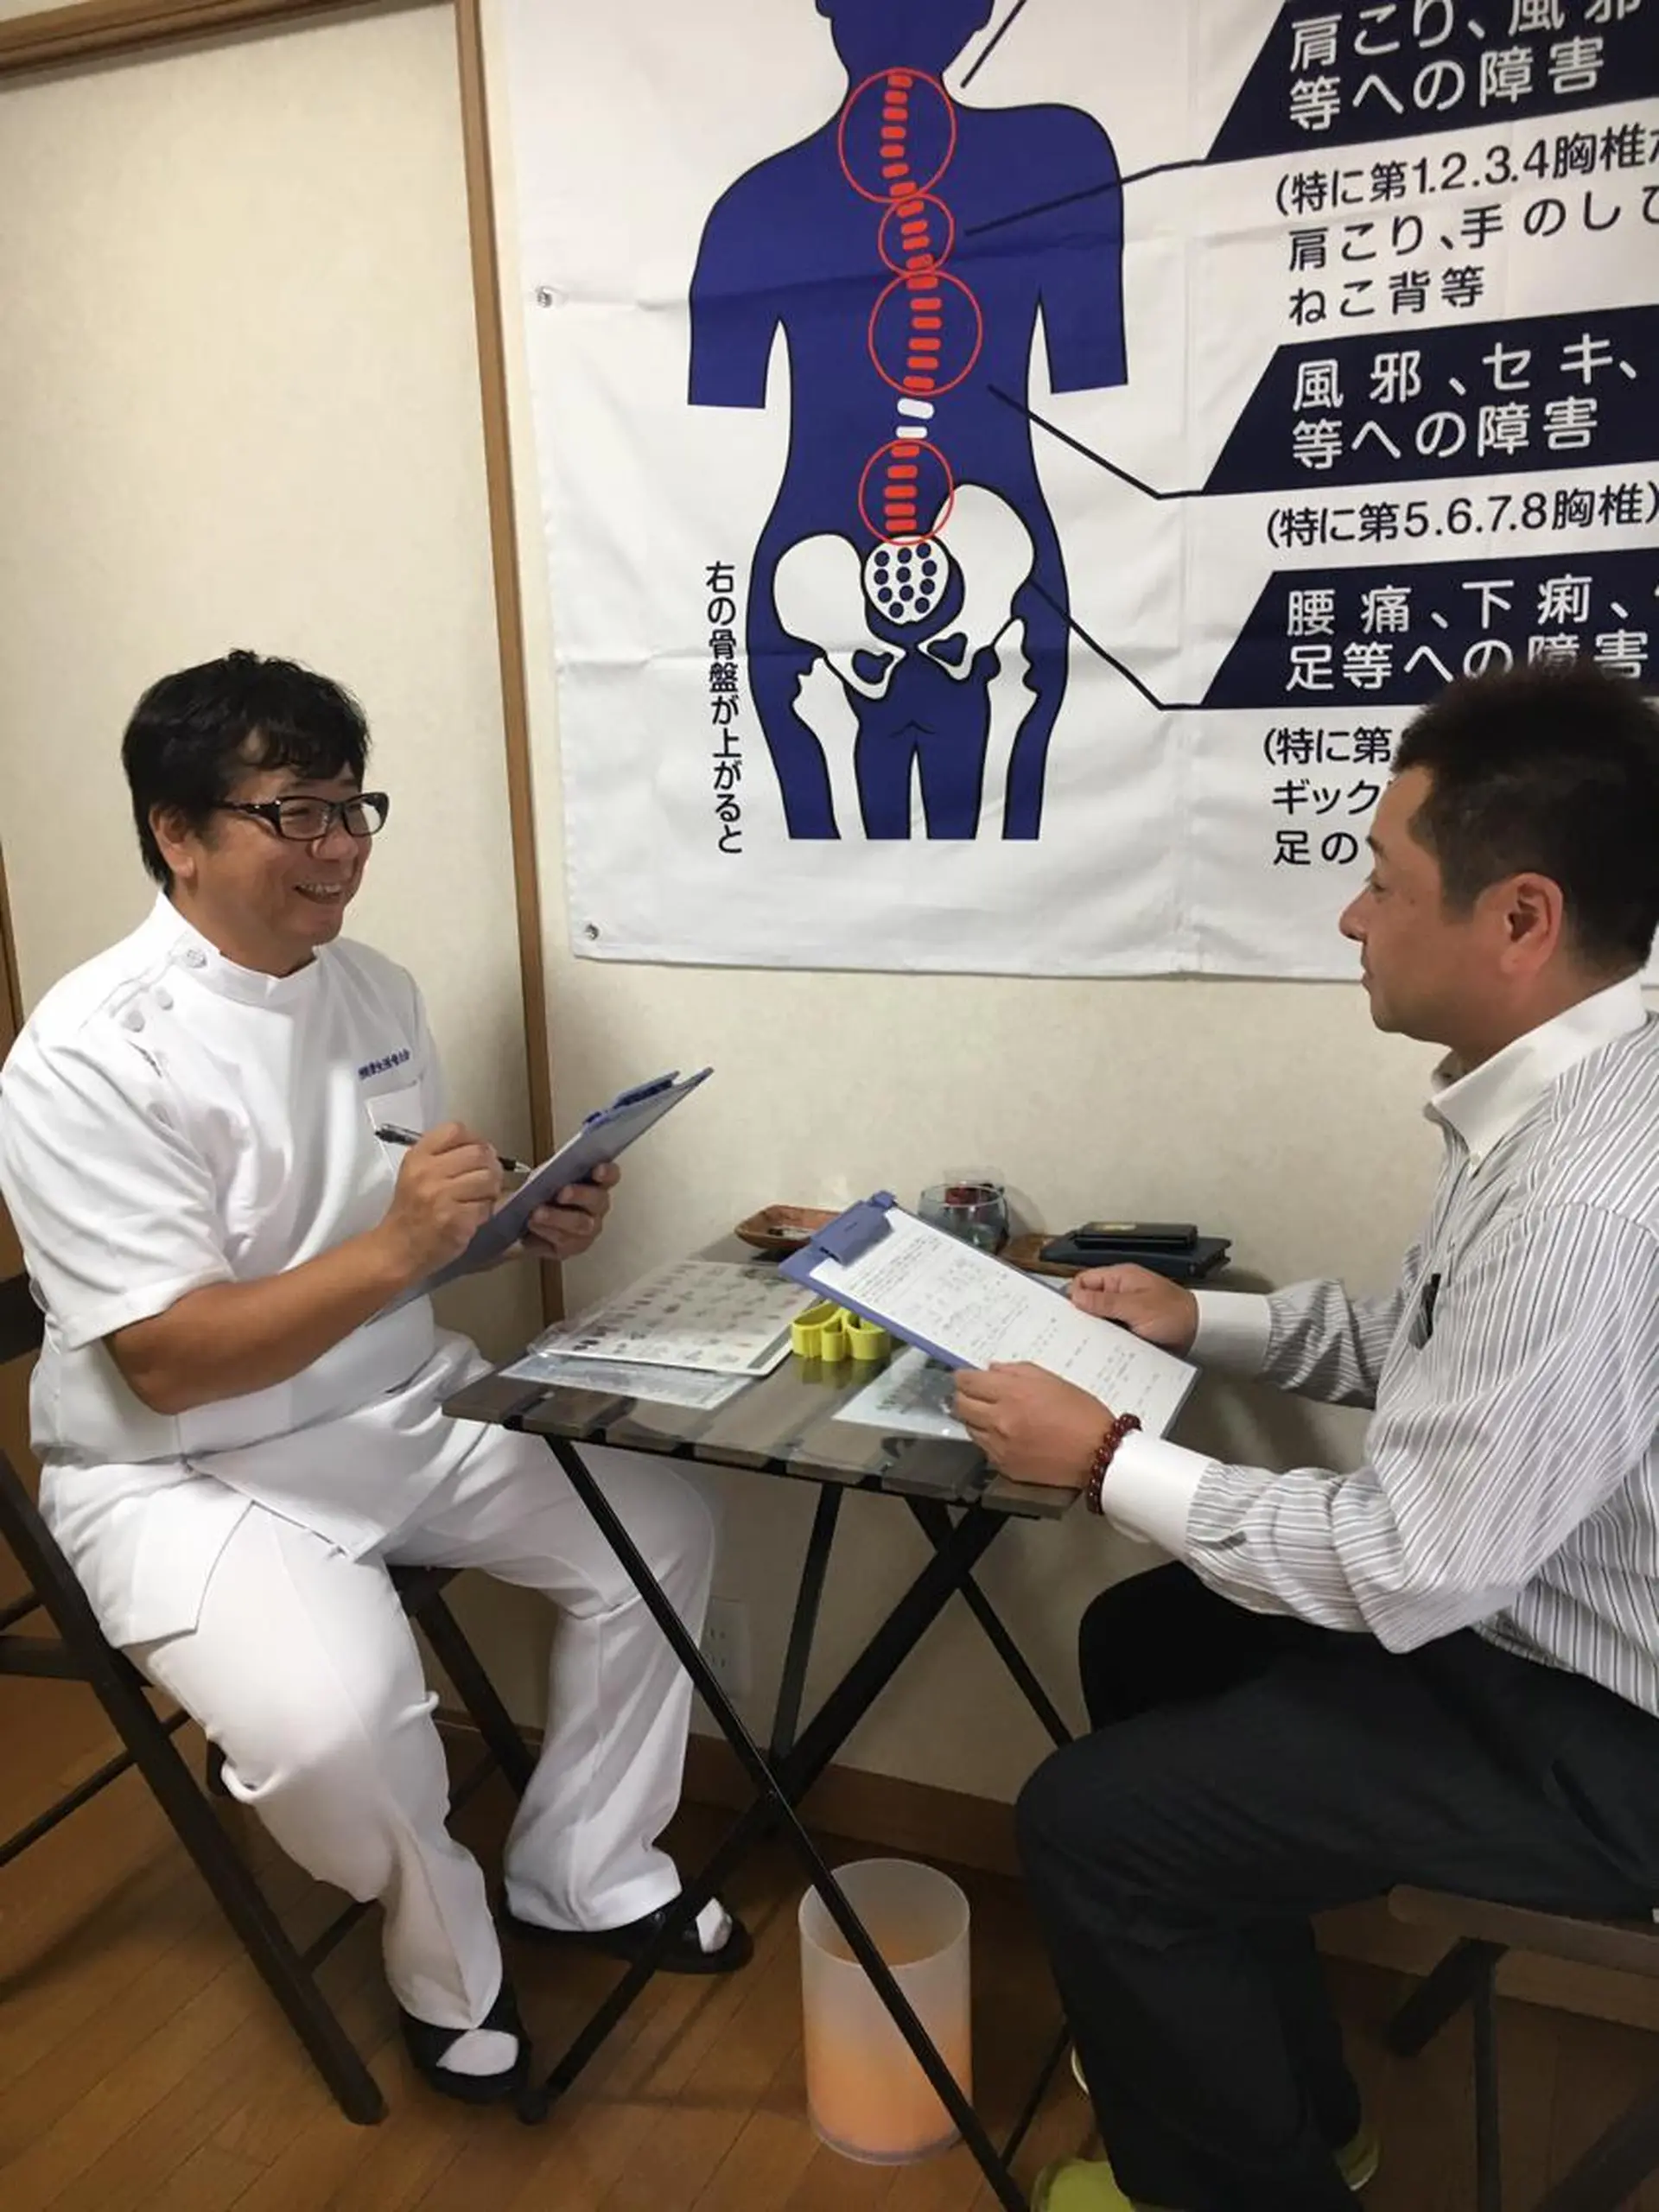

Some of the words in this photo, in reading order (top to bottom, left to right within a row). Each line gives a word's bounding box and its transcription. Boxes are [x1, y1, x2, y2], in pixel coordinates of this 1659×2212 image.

[1289, 35, 1605, 131] 等への障害
[1275, 122, 1659, 216] (特に第1.2.3.4胸椎
[1289, 265, 1484, 327] ねこ背等
[1293, 333, 1637, 411] 風邪、セキ、
[1292, 396, 1599, 470] 等への障害
[1267, 480, 1659, 548] (特に第5.6.7.8胸椎)
[1287, 573, 1659, 638] 腰痛、下痢、
[705, 561, 743, 855] 右の骨盤が上がると
[1263, 727, 1392, 766] (特に第
[1272, 779, 1381, 815] ギック
[1273, 830, 1358, 866] 足の
